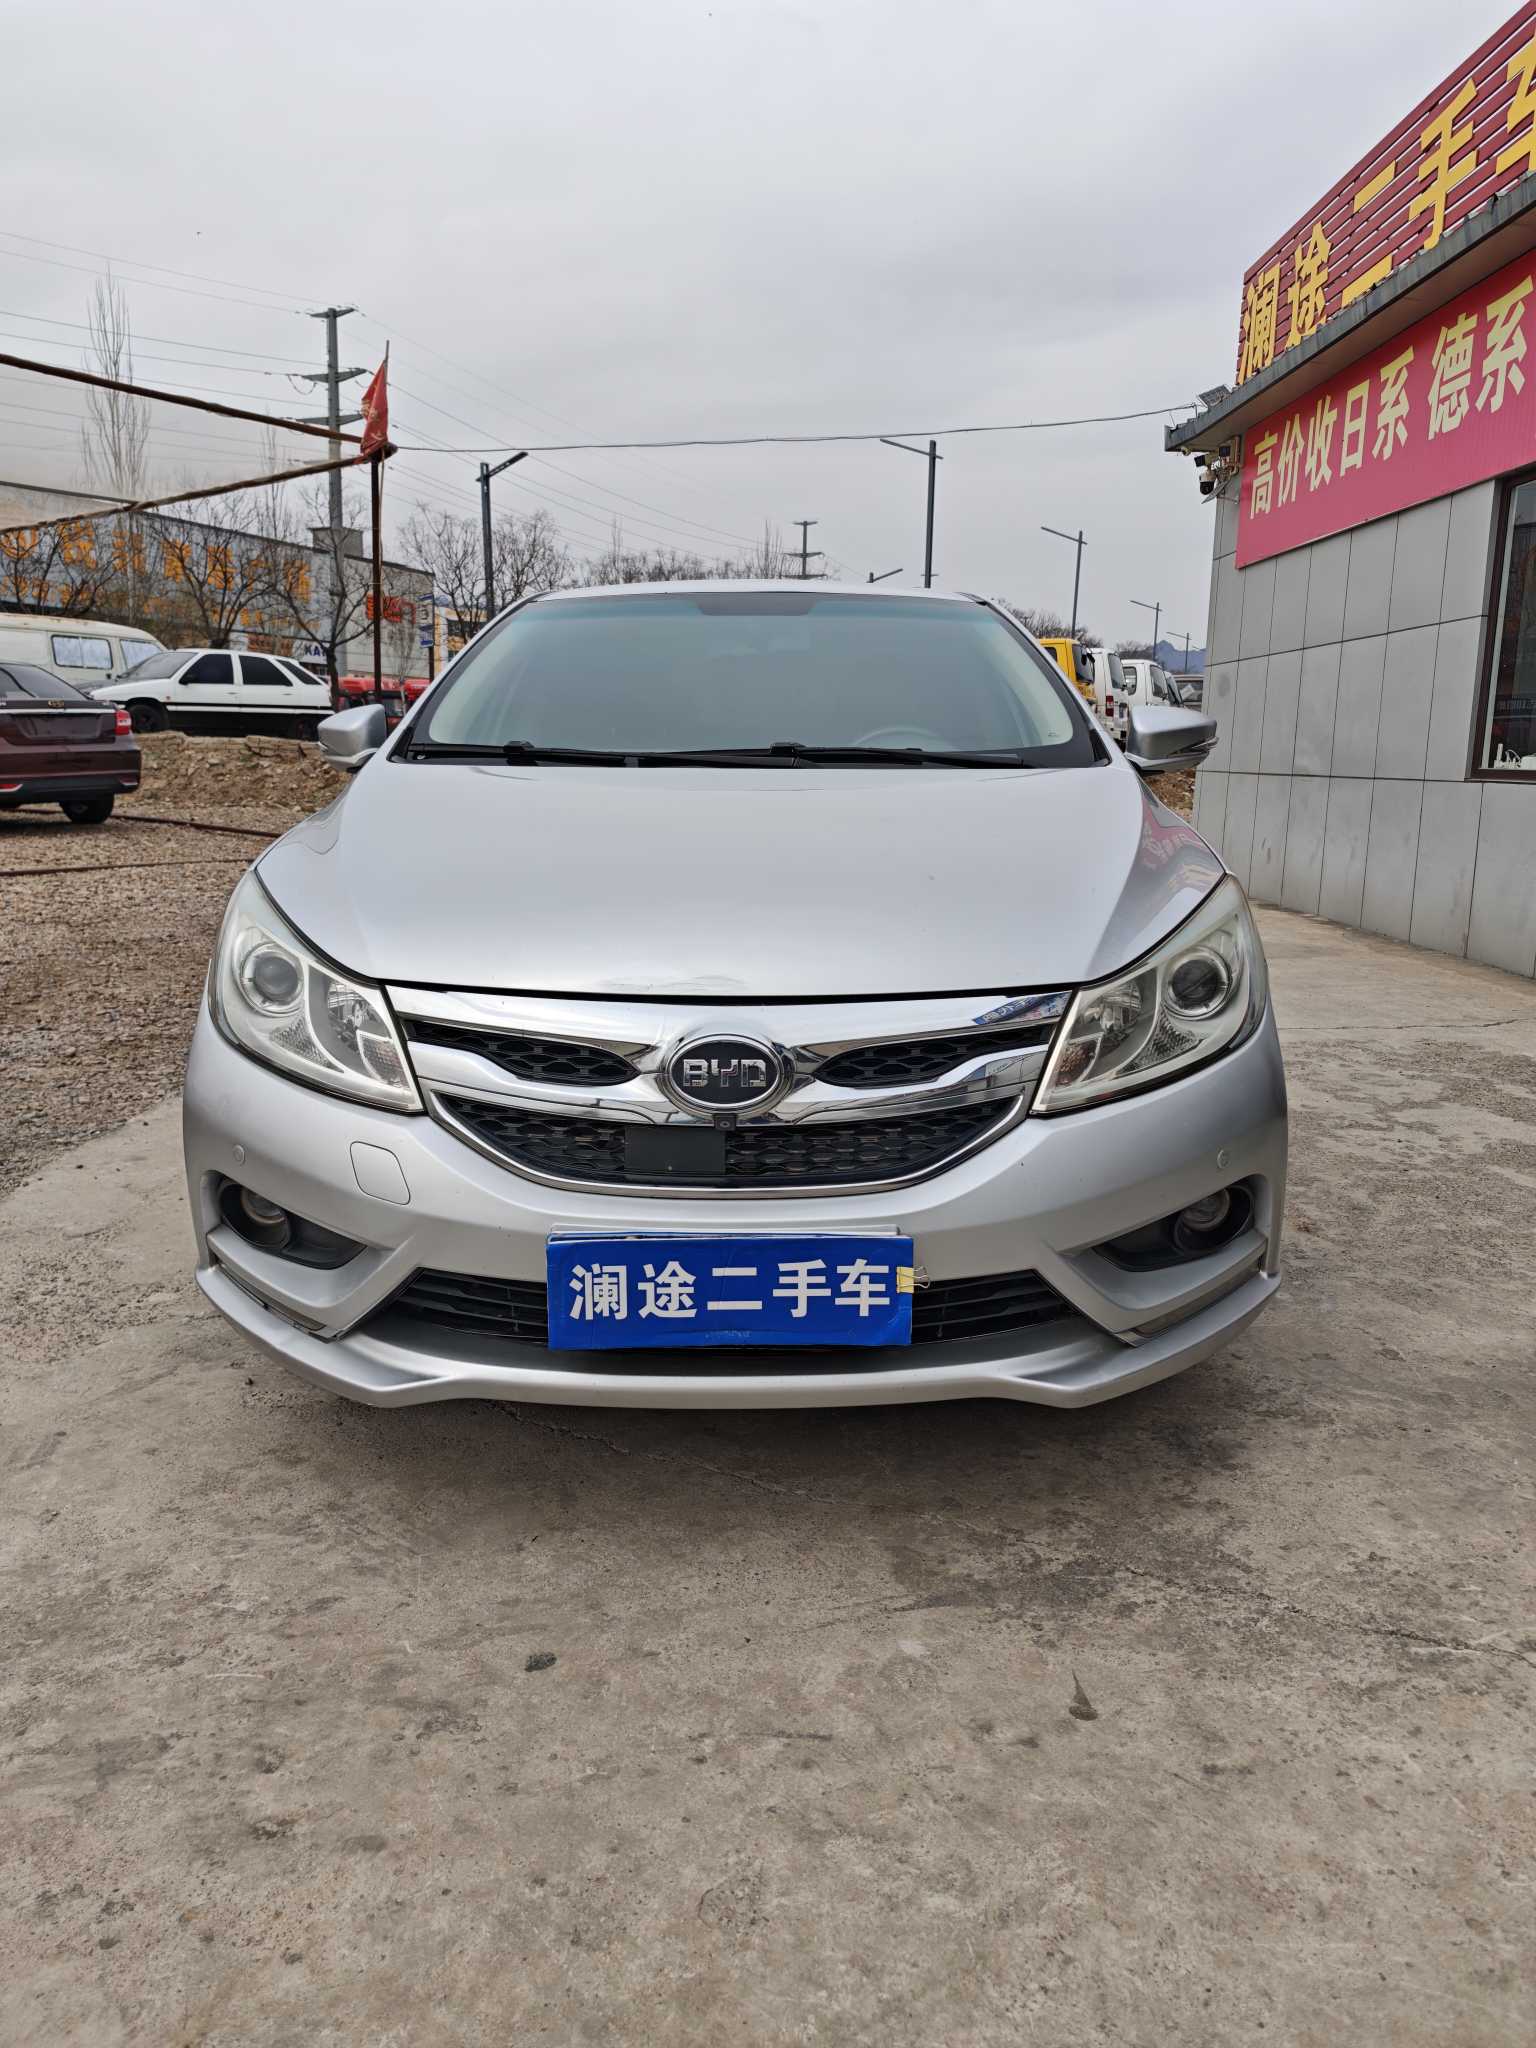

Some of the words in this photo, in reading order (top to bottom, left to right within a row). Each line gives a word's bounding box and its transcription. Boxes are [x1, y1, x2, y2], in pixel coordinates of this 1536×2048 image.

[1250, 345, 1415, 519] 高价收日系
[1427, 275, 1534, 440] 德系
[683, 1058, 767, 1088] BYD
[569, 1258, 891, 1321] 澜途二手车
